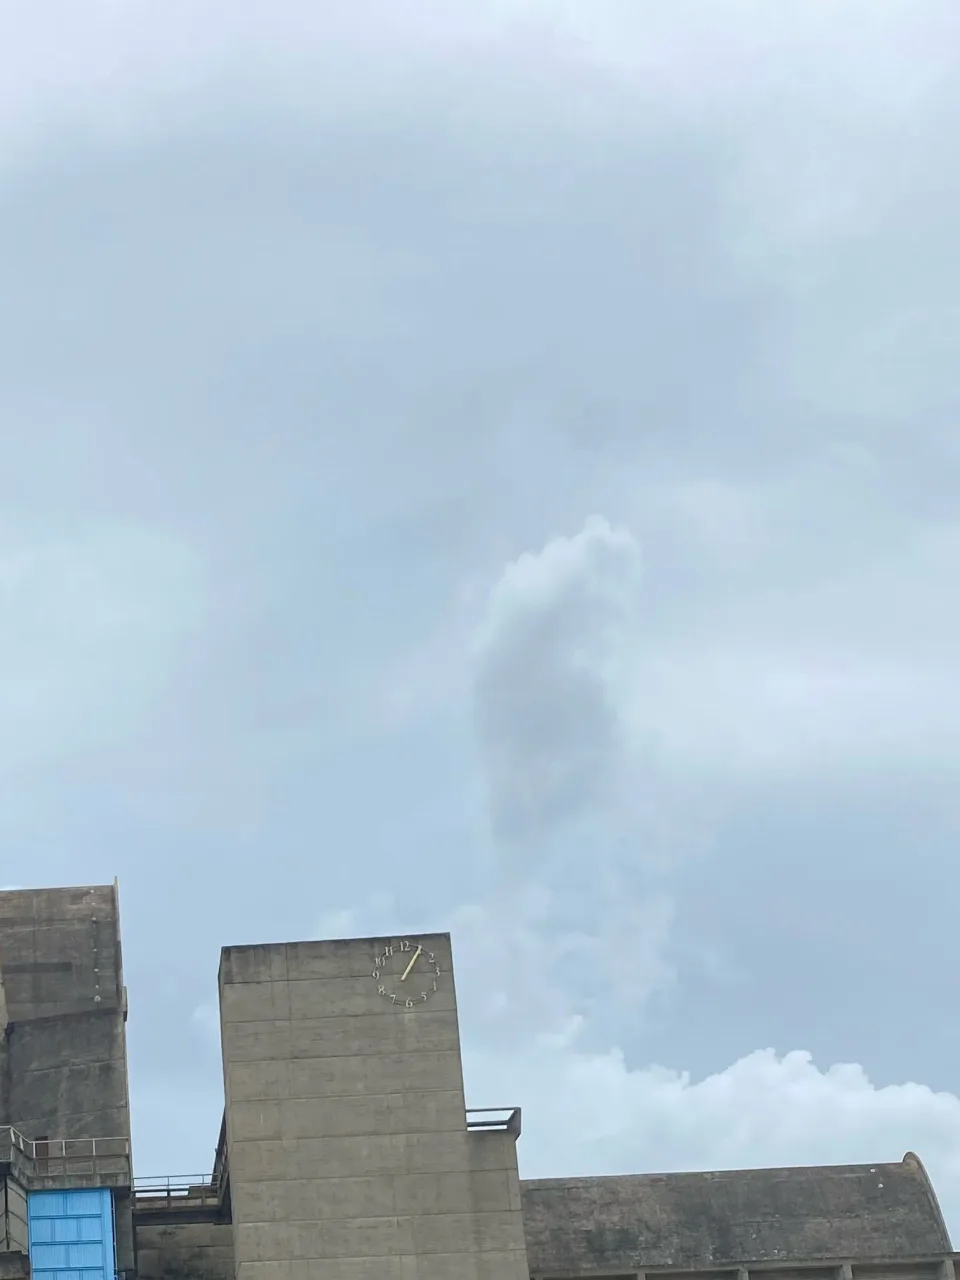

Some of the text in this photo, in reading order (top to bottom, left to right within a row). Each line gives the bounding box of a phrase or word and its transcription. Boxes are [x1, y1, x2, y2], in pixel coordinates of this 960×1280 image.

[400, 940, 411, 951] 12
[385, 946, 394, 956] 11
[429, 953, 434, 962] 2
[372, 971, 380, 980] 9
[435, 967, 440, 977] 3
[378, 985, 385, 995] 8
[390, 994, 396, 1004] 7
[421, 991, 427, 1001] 5
[405, 997, 413, 1007] 6
